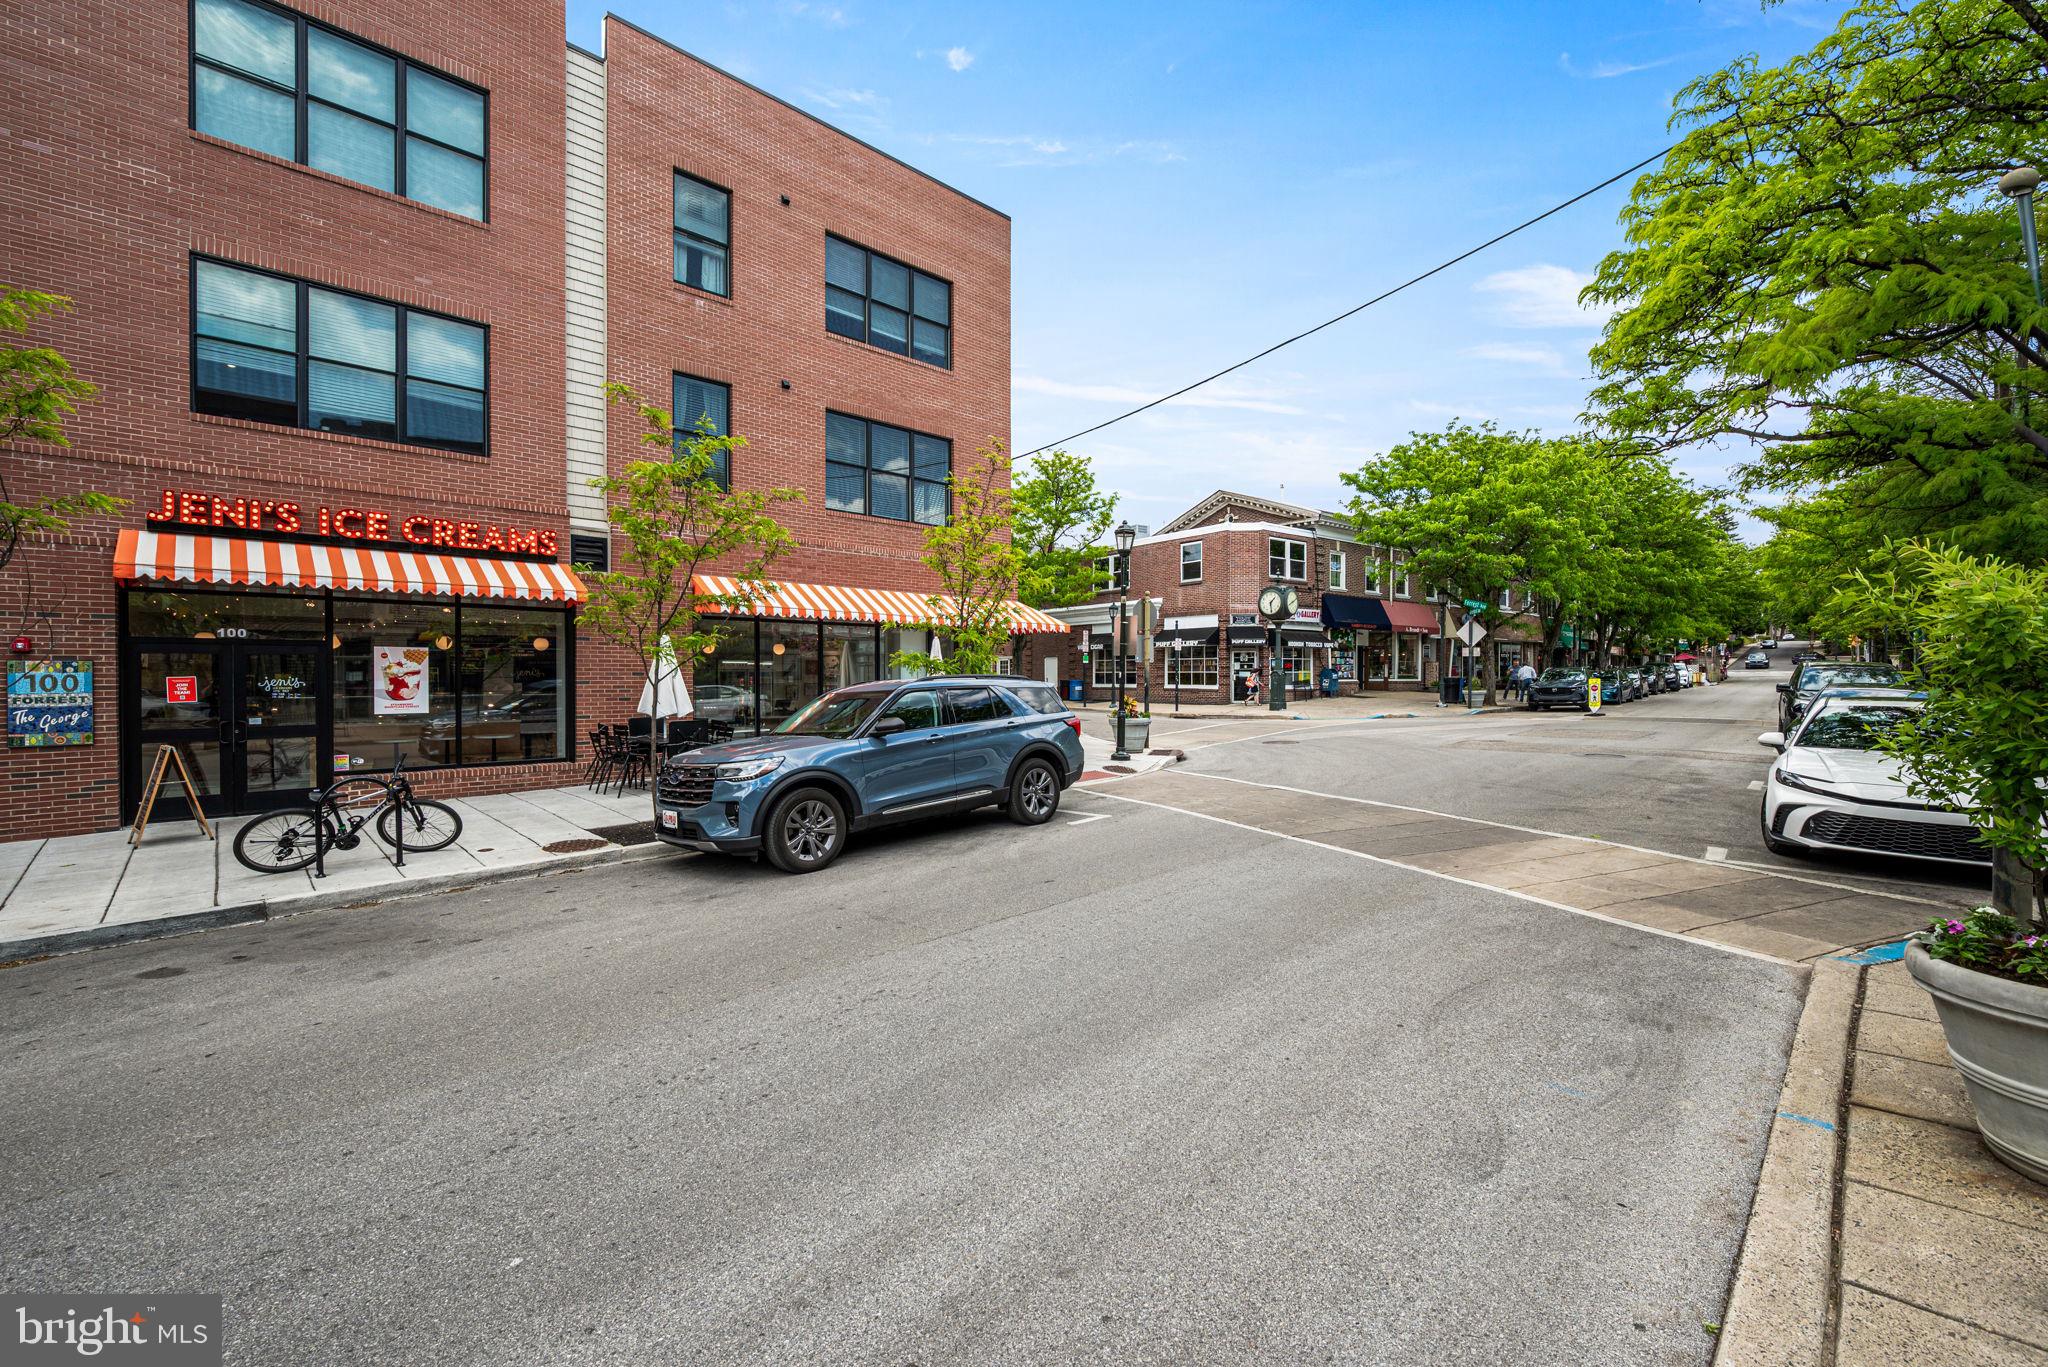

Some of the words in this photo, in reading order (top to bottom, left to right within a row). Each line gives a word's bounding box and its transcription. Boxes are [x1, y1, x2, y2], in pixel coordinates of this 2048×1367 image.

[146, 489, 301, 533] JENI'S
[319, 506, 389, 541] ICE
[401, 515, 559, 556] CREAMS
[1301, 610, 1320, 619] GALLERY
[216, 627, 247, 638] 100
[23, 674, 79, 693] 100
[12, 695, 89, 705] FORREST
[12, 709, 36, 725] The
[40, 710, 89, 733] George
